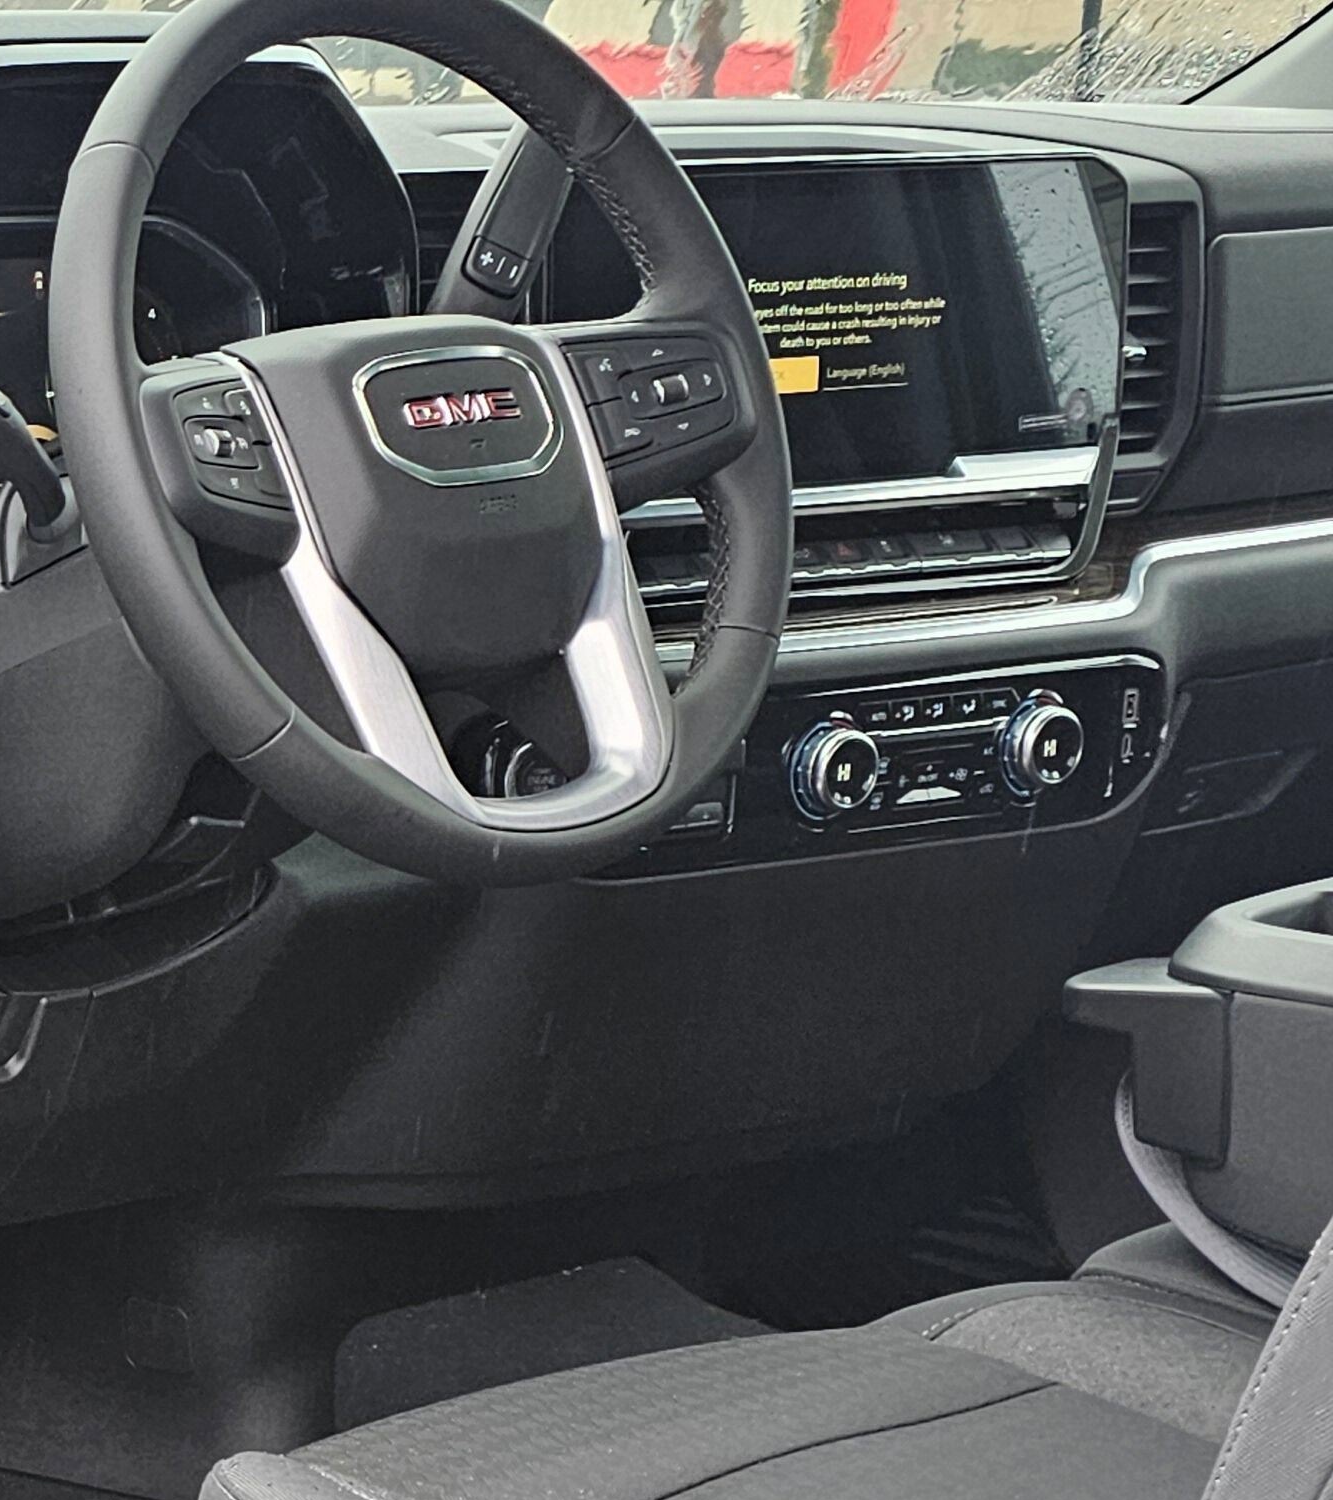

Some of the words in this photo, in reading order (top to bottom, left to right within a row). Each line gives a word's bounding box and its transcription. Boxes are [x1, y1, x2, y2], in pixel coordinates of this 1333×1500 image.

[747, 278, 780, 294] Focus
[779, 279, 805, 296] your
[806, 275, 854, 291] attention
[856, 276, 870, 288] on
[871, 272, 908, 290] driving
[775, 304, 789, 317] off
[789, 303, 803, 316] the
[804, 303, 824, 316] road
[825, 302, 838, 315] for
[838, 303, 853, 314] too
[854, 301, 873, 315] long
[874, 302, 885, 312] or
[884, 301, 899, 311] too
[900, 298, 923, 311] often
[782, 319, 805, 332] could
[806, 321, 830, 331] cause
[831, 320, 837, 330] a
[838, 317, 861, 330] crash
[862, 315, 897, 330] resulting
[898, 315, 907, 325] in
[907, 314, 931, 328] injury
[931, 315, 942, 324] or
[780, 335, 805, 349] death
[805, 337, 815, 347] to
[815, 337, 831, 350] you
[832, 336, 842, 346] or
[826, 367, 867, 381] Language
[868, 362, 906, 378] (English)
[402, 389, 523, 429] GMC
